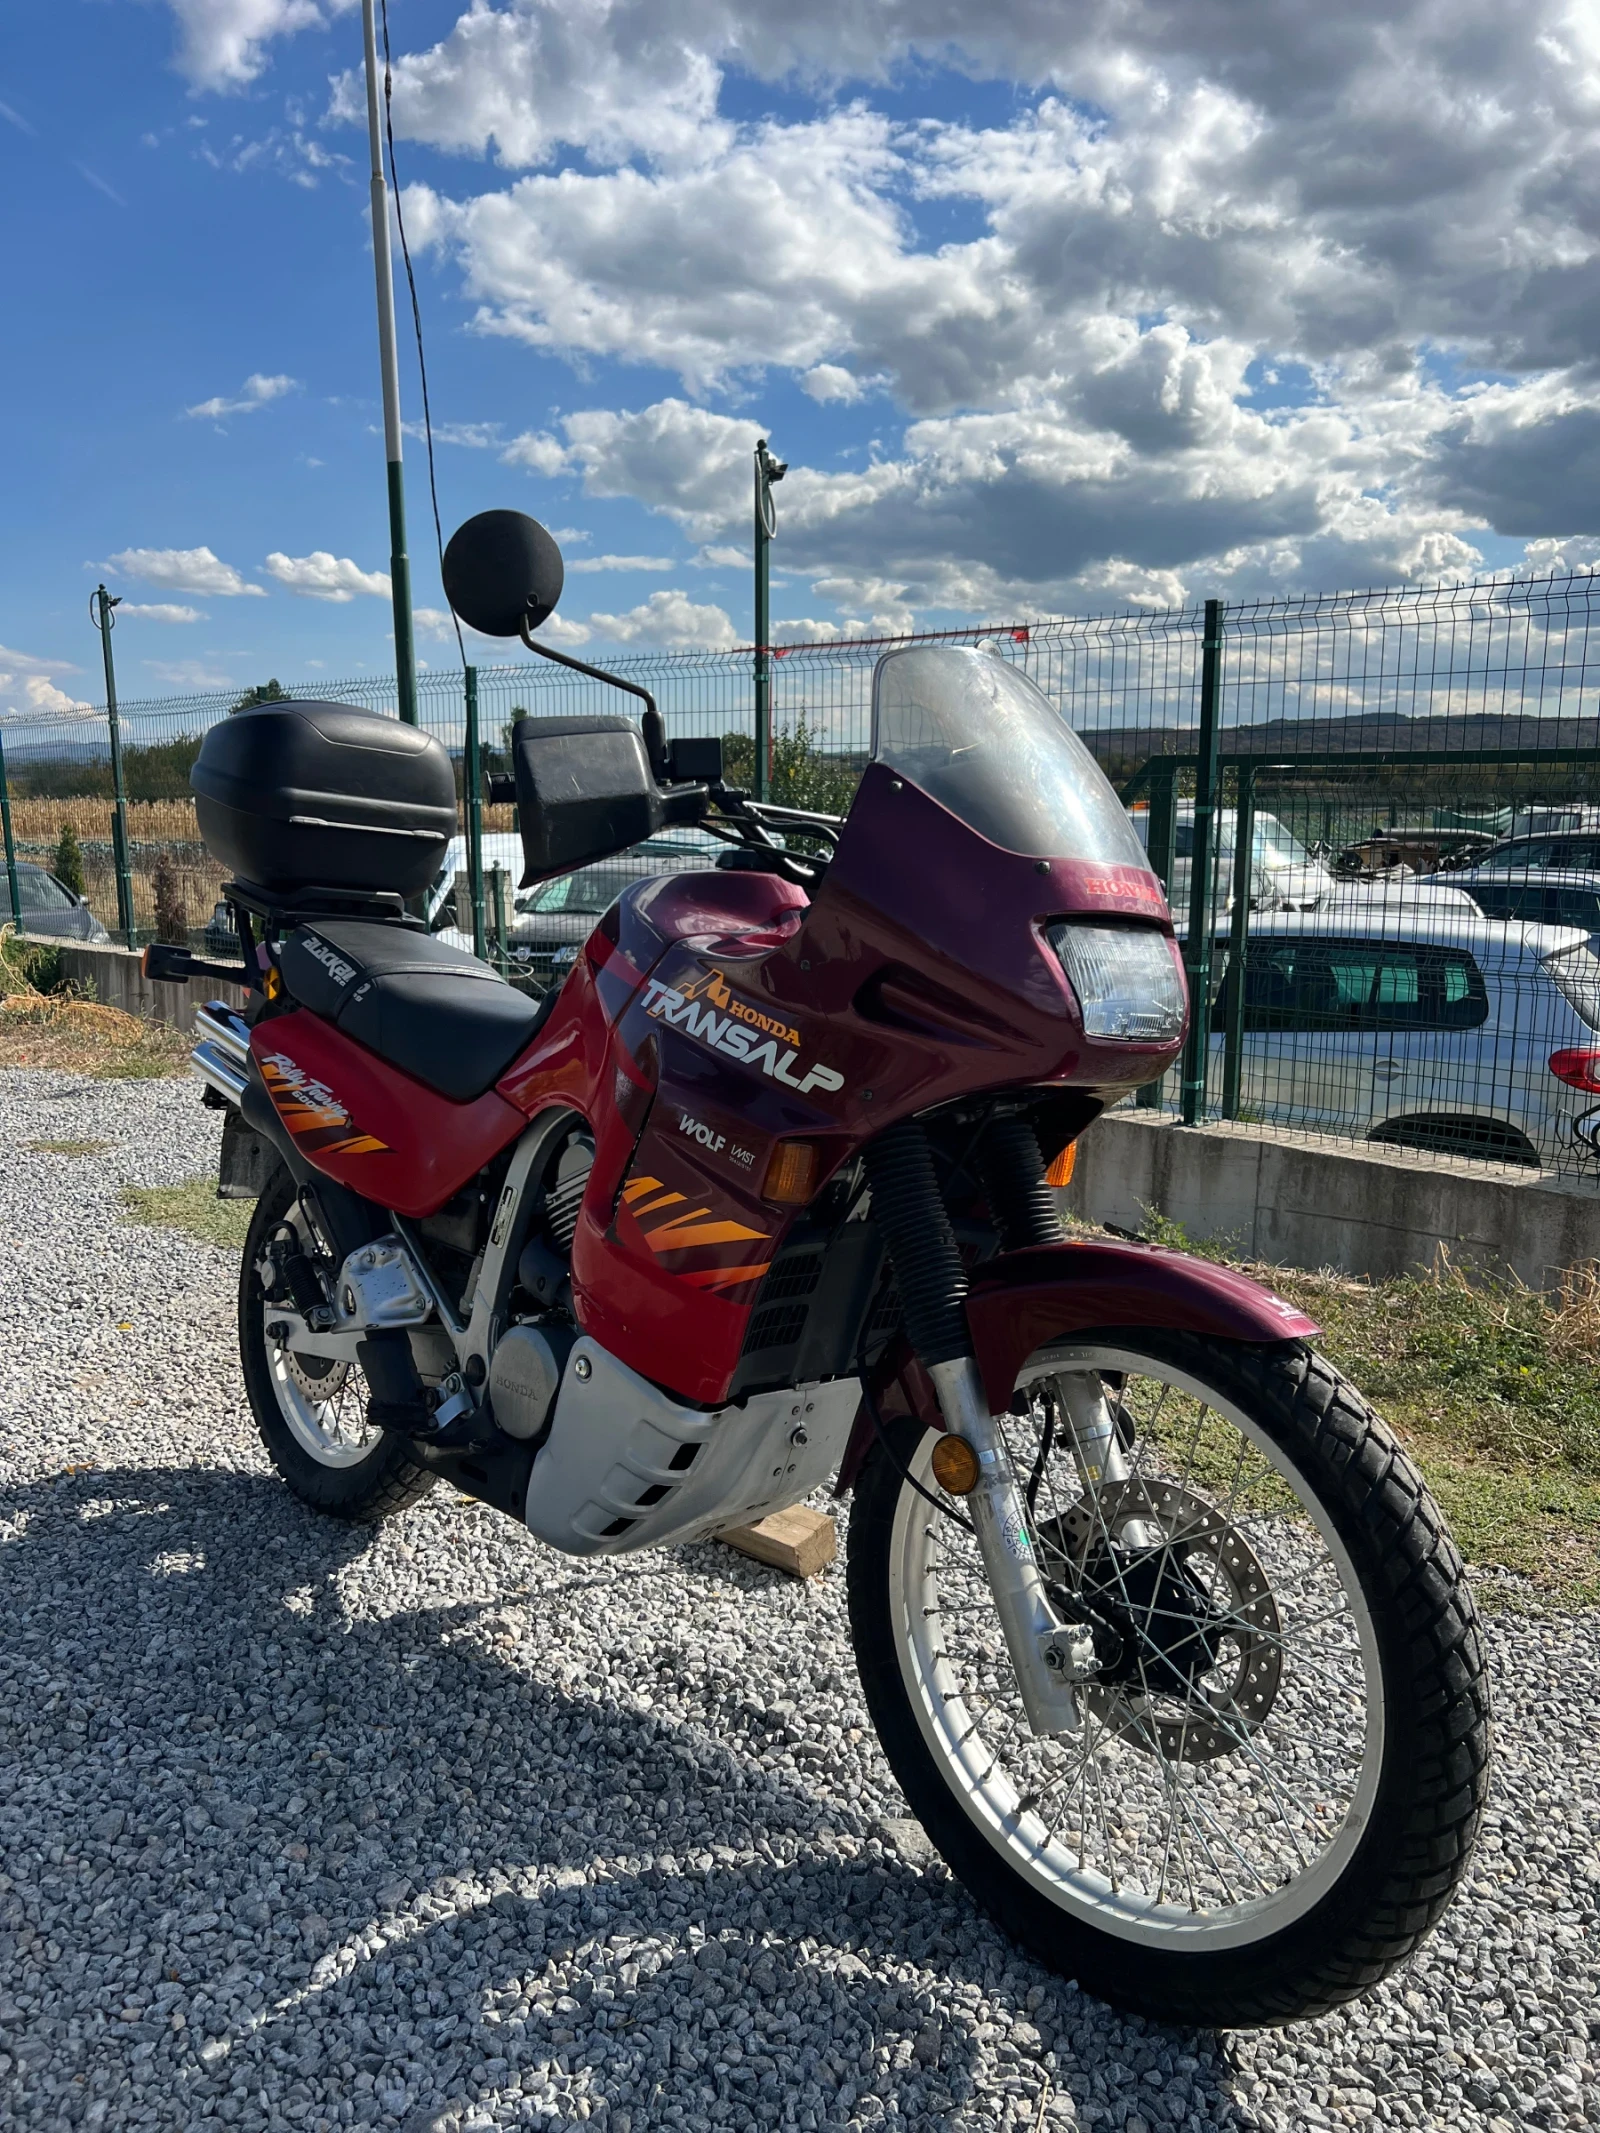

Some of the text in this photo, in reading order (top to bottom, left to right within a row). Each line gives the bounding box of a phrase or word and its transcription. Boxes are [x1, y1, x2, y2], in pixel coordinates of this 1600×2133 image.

[640, 978, 845, 1094] TRANSALP
[729, 999, 801, 1047] HONDA
[261, 1052, 349, 1120] Rally Touring
[679, 1113, 726, 1153] WOLF
[496, 1374, 538, 1401] HONDA
